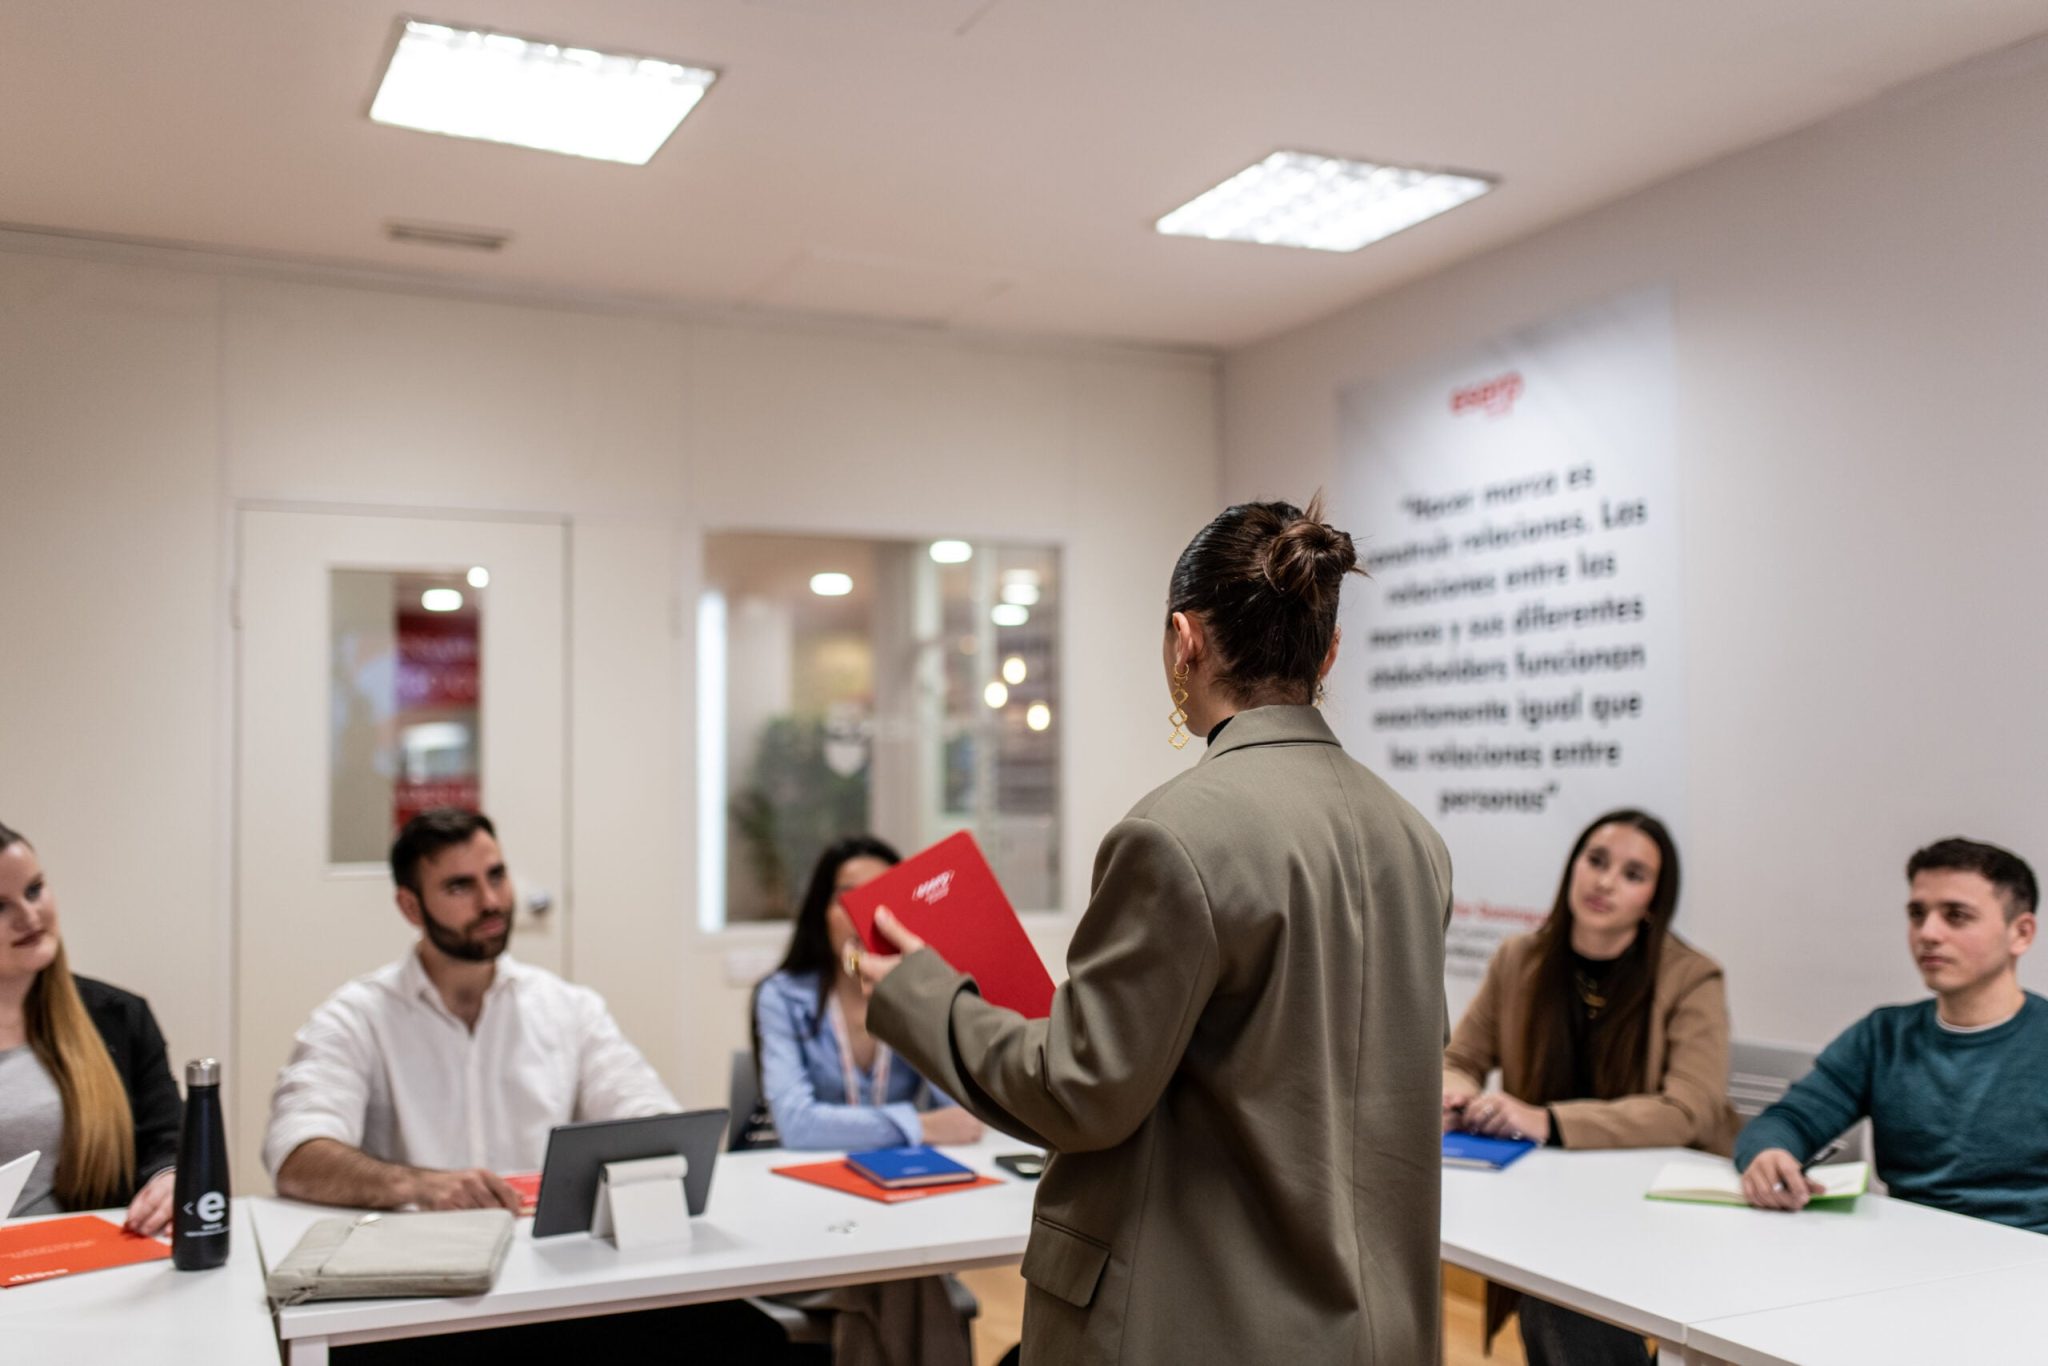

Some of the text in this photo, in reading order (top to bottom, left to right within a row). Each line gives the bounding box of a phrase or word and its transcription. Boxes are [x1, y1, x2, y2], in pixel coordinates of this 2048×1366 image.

[1566, 465, 1595, 487] es
[1600, 500, 1649, 530] Las
[1503, 560, 1569, 588] entre
[1577, 551, 1617, 579] las
[1511, 596, 1645, 635] diferentes
[1514, 643, 1647, 679] funcionan
[1517, 689, 1583, 731] igual
[1589, 693, 1643, 727] que
[1550, 739, 1622, 768] entre
